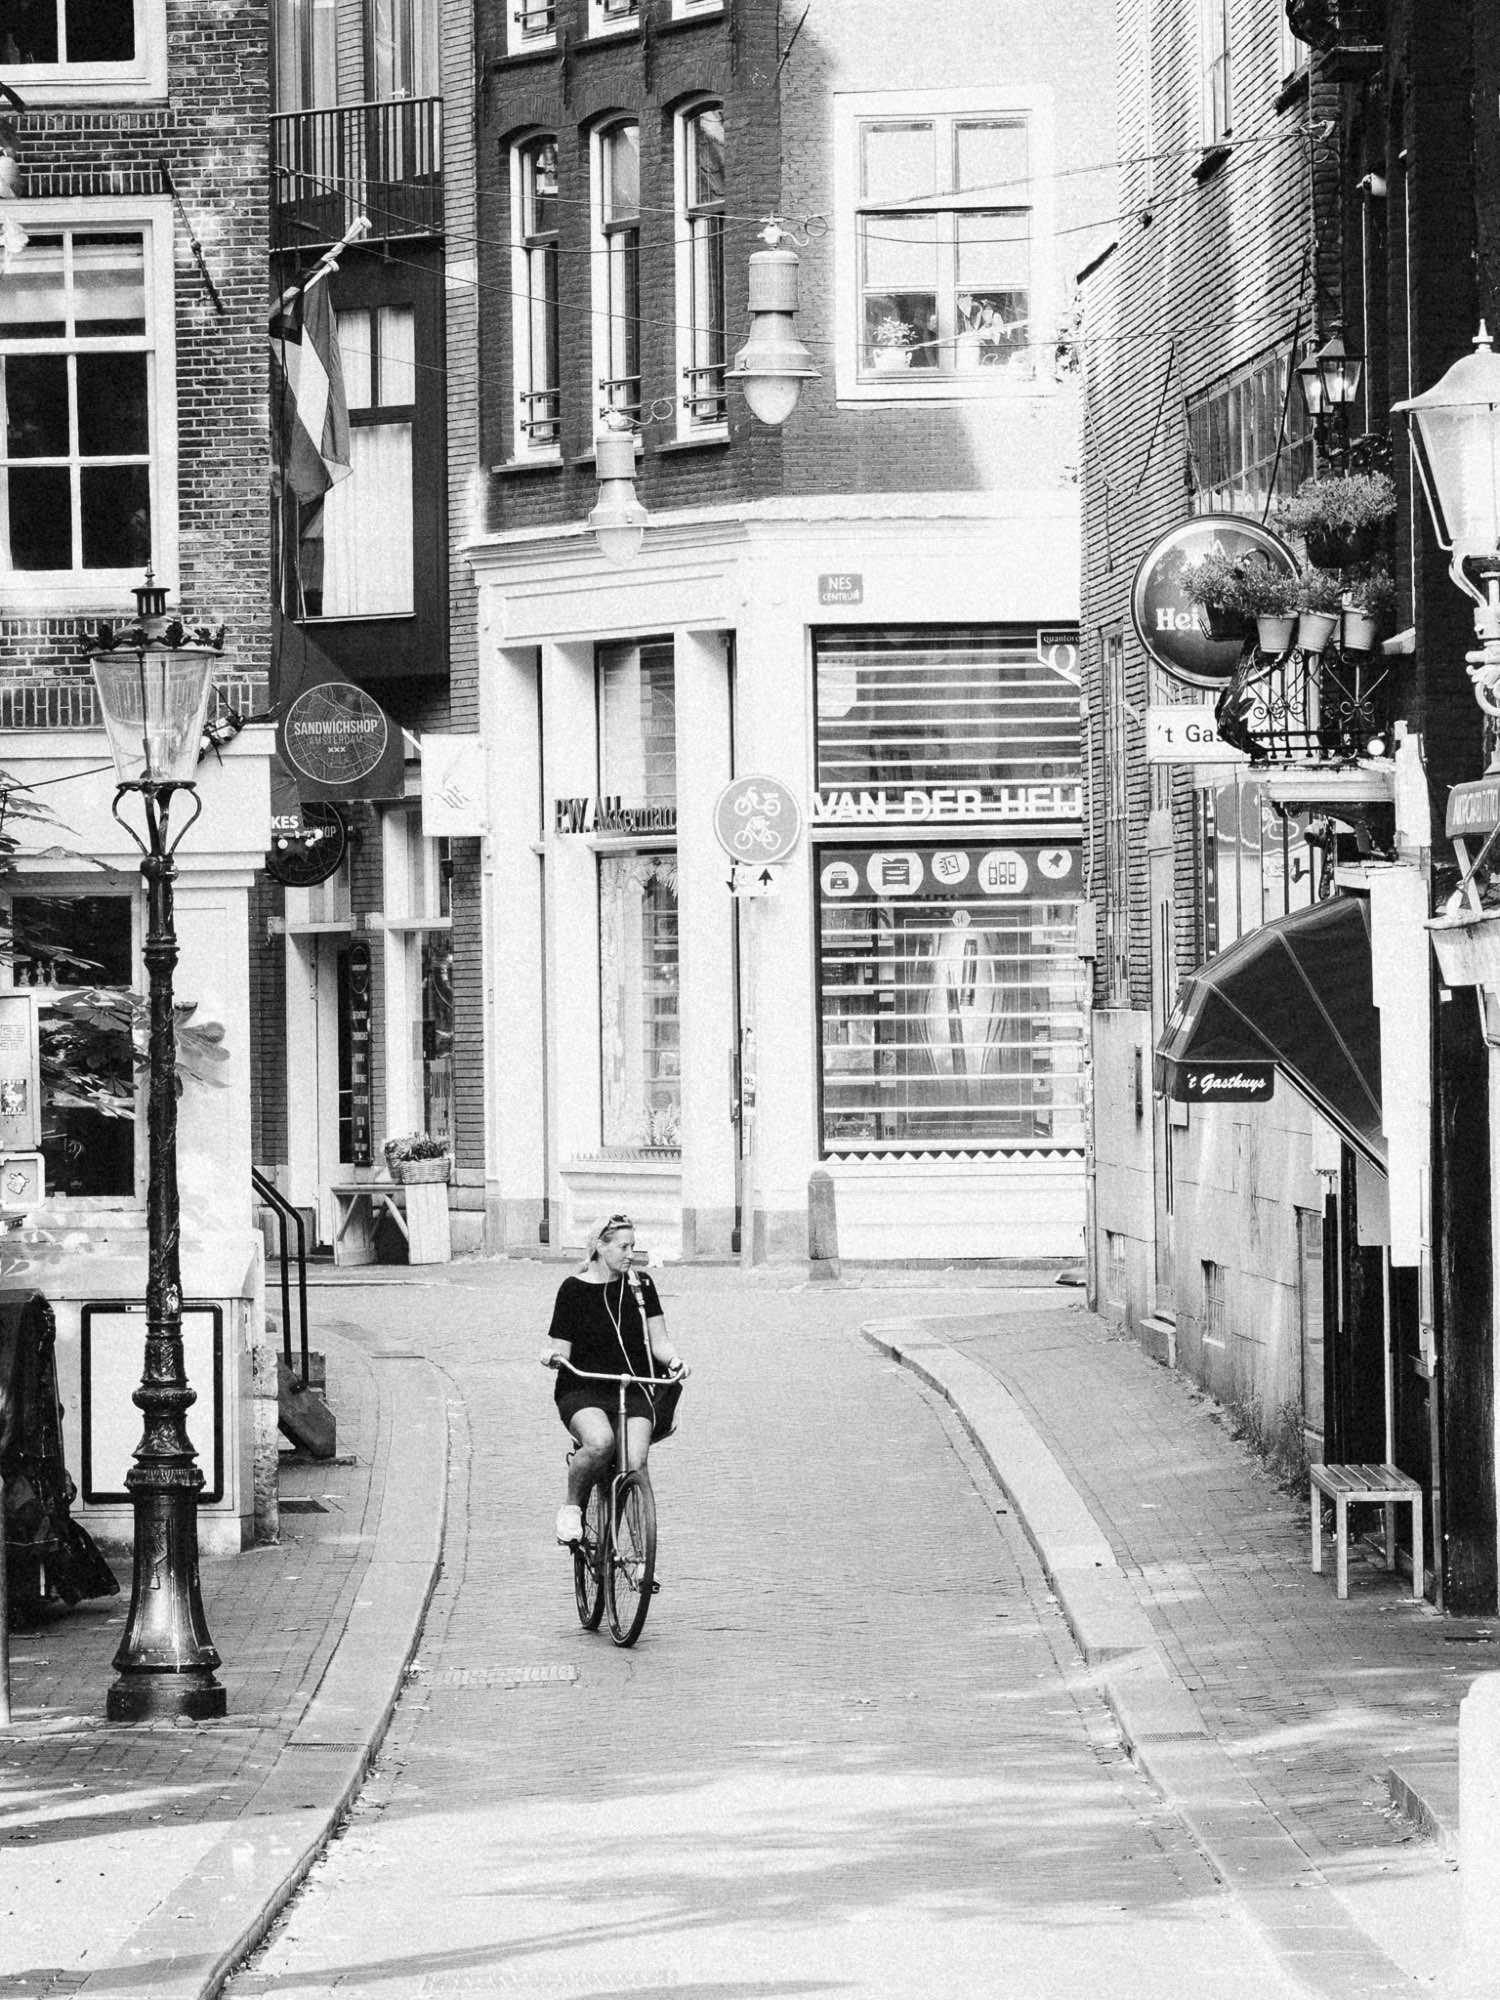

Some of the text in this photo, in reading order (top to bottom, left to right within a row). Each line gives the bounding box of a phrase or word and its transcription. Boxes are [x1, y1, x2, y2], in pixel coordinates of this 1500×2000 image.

[829, 576, 851, 590] NES
[293, 719, 378, 735] SANDWICHSHOP
[812, 791, 887, 820] VAN
[903, 789, 982, 819] DER
[270, 815, 299, 829] KES
[1200, 1072, 1267, 1095] Gasthuys
